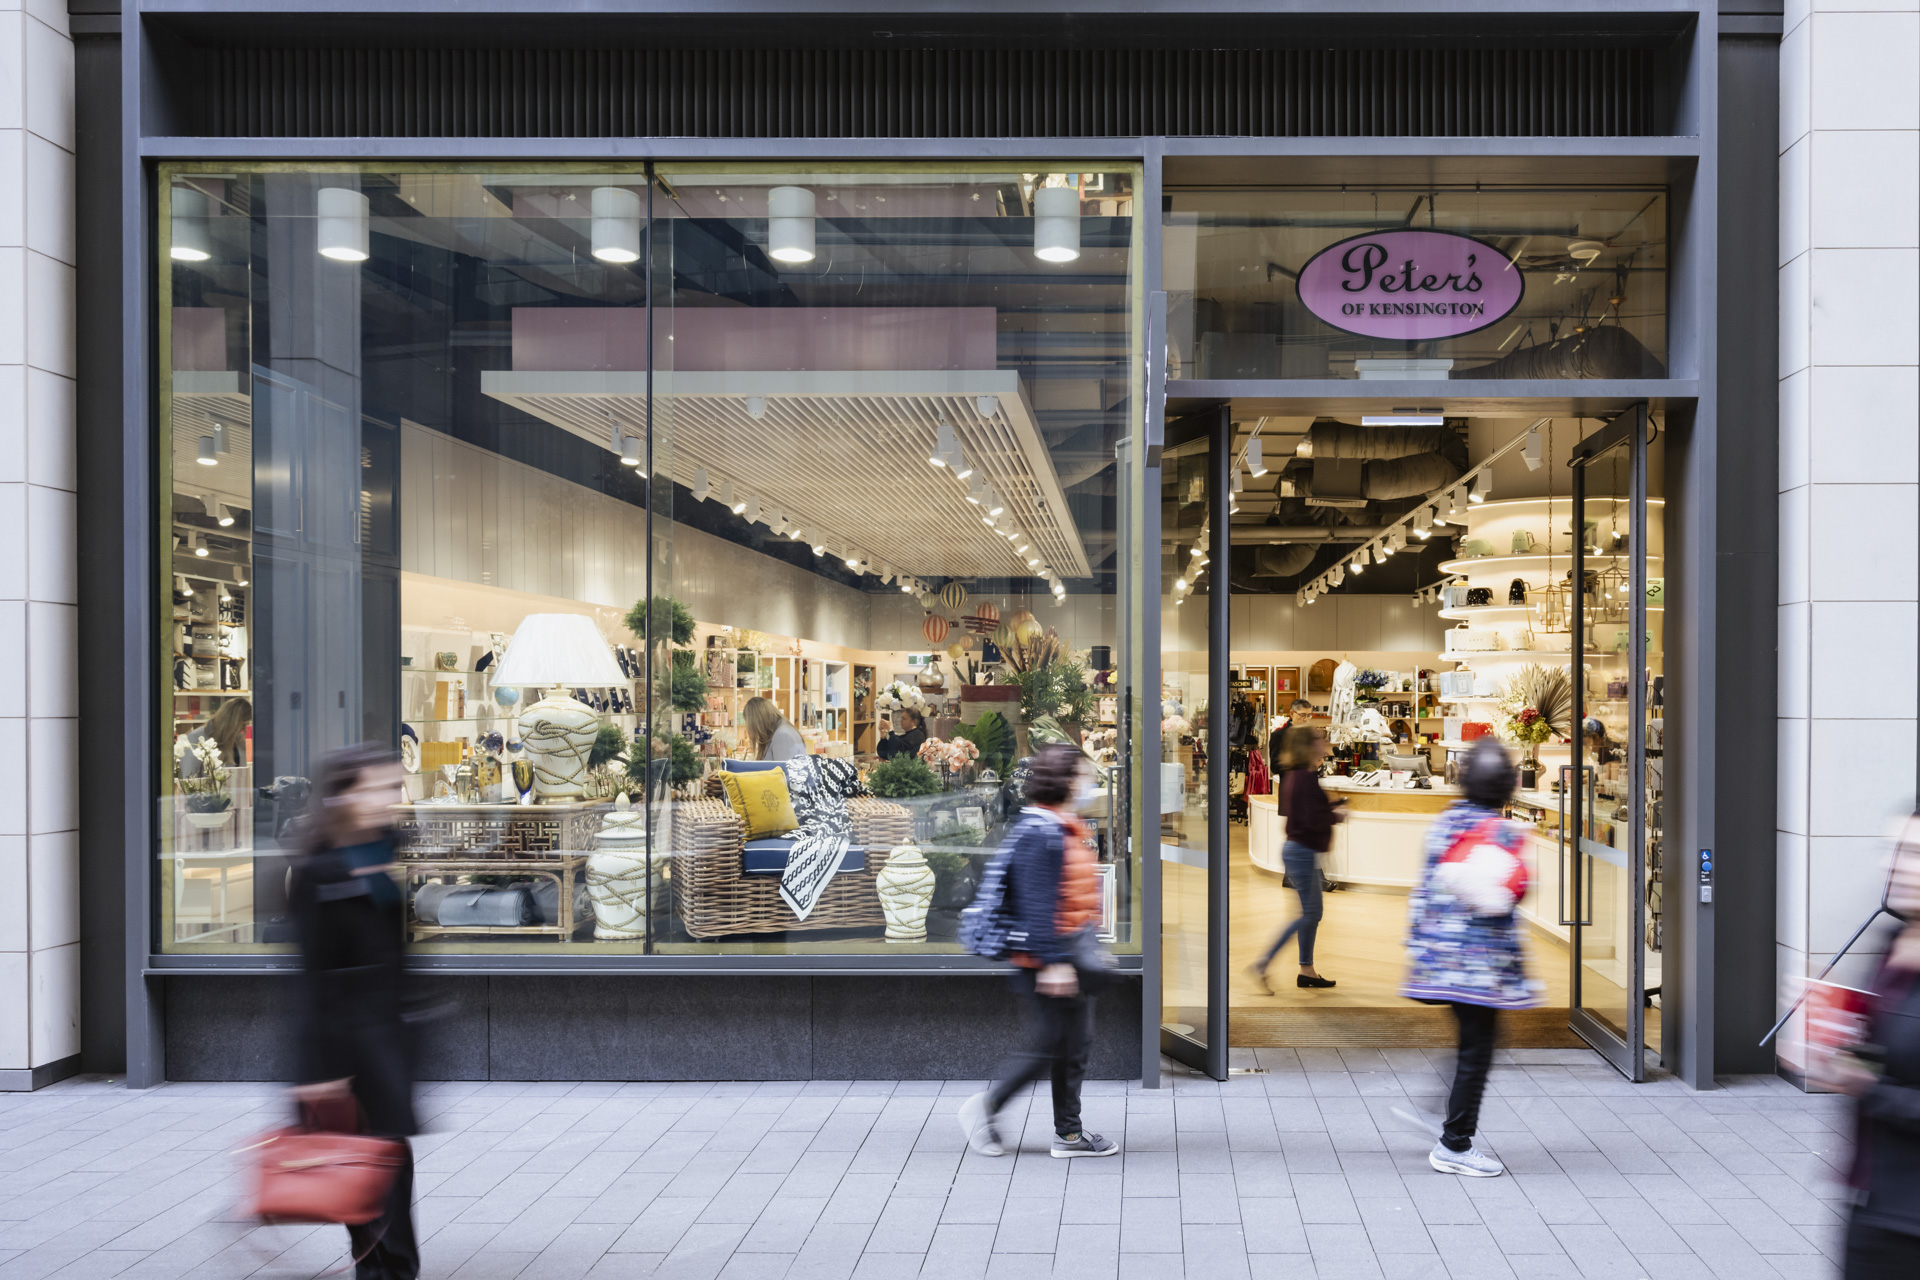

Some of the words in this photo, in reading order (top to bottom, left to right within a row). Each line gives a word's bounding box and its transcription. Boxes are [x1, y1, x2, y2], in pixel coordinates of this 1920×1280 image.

[1341, 243, 1483, 293] Peter's
[1341, 302, 1365, 316] OF
[1369, 302, 1484, 316] KENSINGTON
